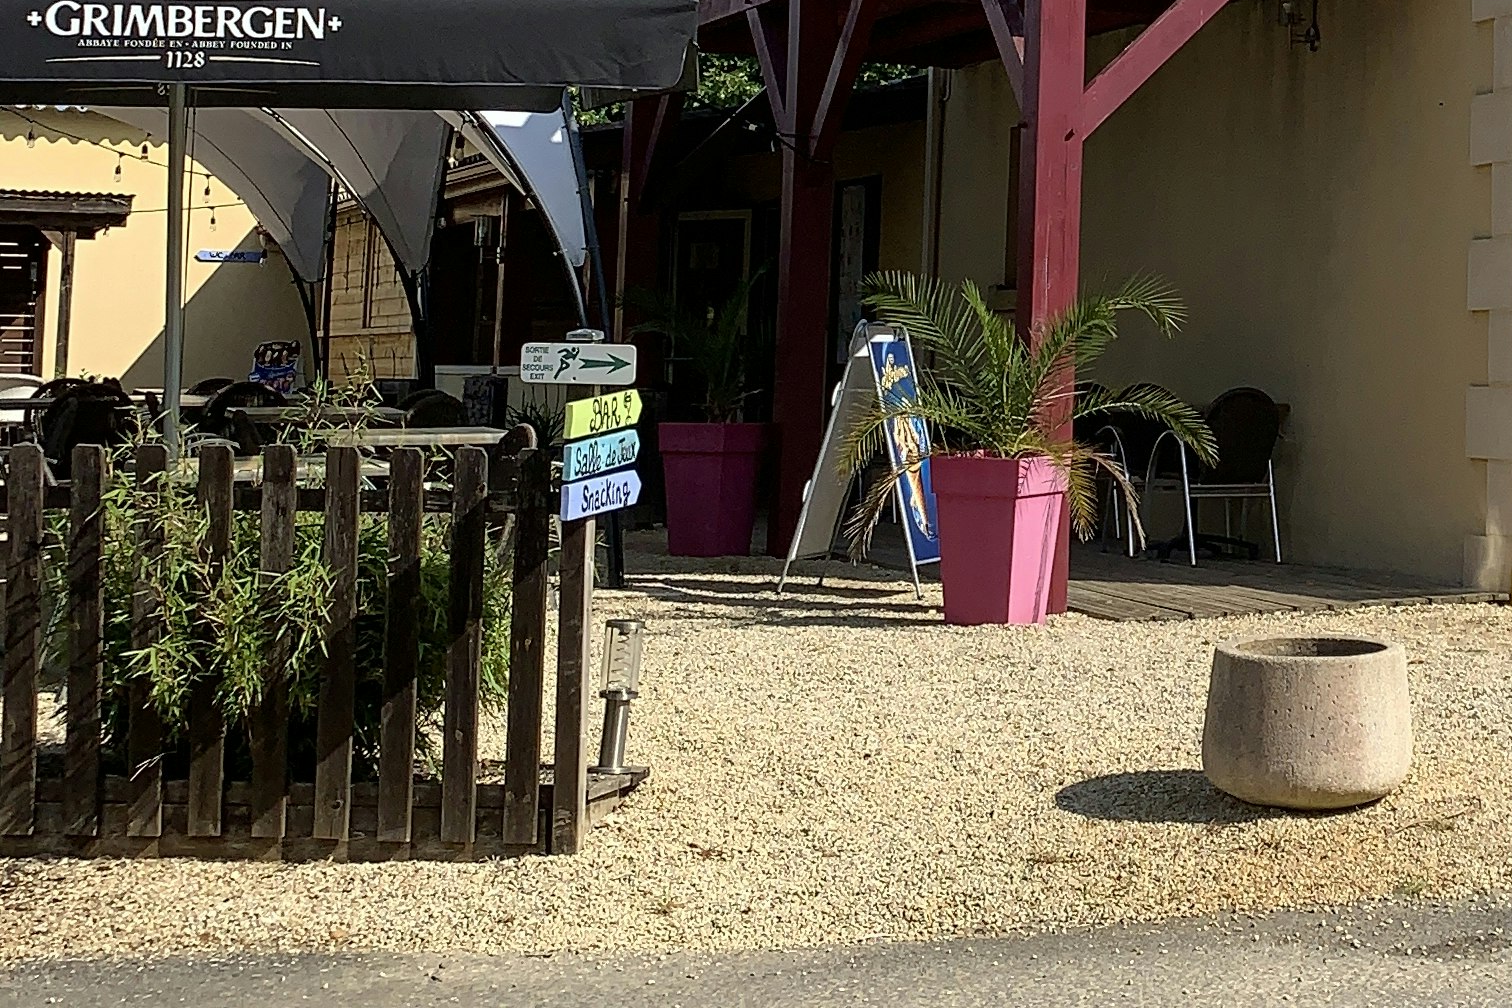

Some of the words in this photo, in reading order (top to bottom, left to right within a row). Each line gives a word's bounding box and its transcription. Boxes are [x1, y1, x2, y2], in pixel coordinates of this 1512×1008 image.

[45, 0, 325, 40] GRIMBERGEN
[77, 38, 120, 48] ABBAYE
[124, 37, 166, 49] FONDÉE
[169, 40, 183, 48] EN
[191, 40, 226, 49] ABBEY
[230, 41, 278, 50] FOUNDED
[281, 41, 293, 50] IN
[166, 50, 206, 69] 1128
[524, 346, 550, 354] SORTIE
[522, 363, 554, 372] SECOURS
[590, 396, 621, 432] BAR
[574, 439, 602, 477] Salle
[605, 442, 617, 468] de
